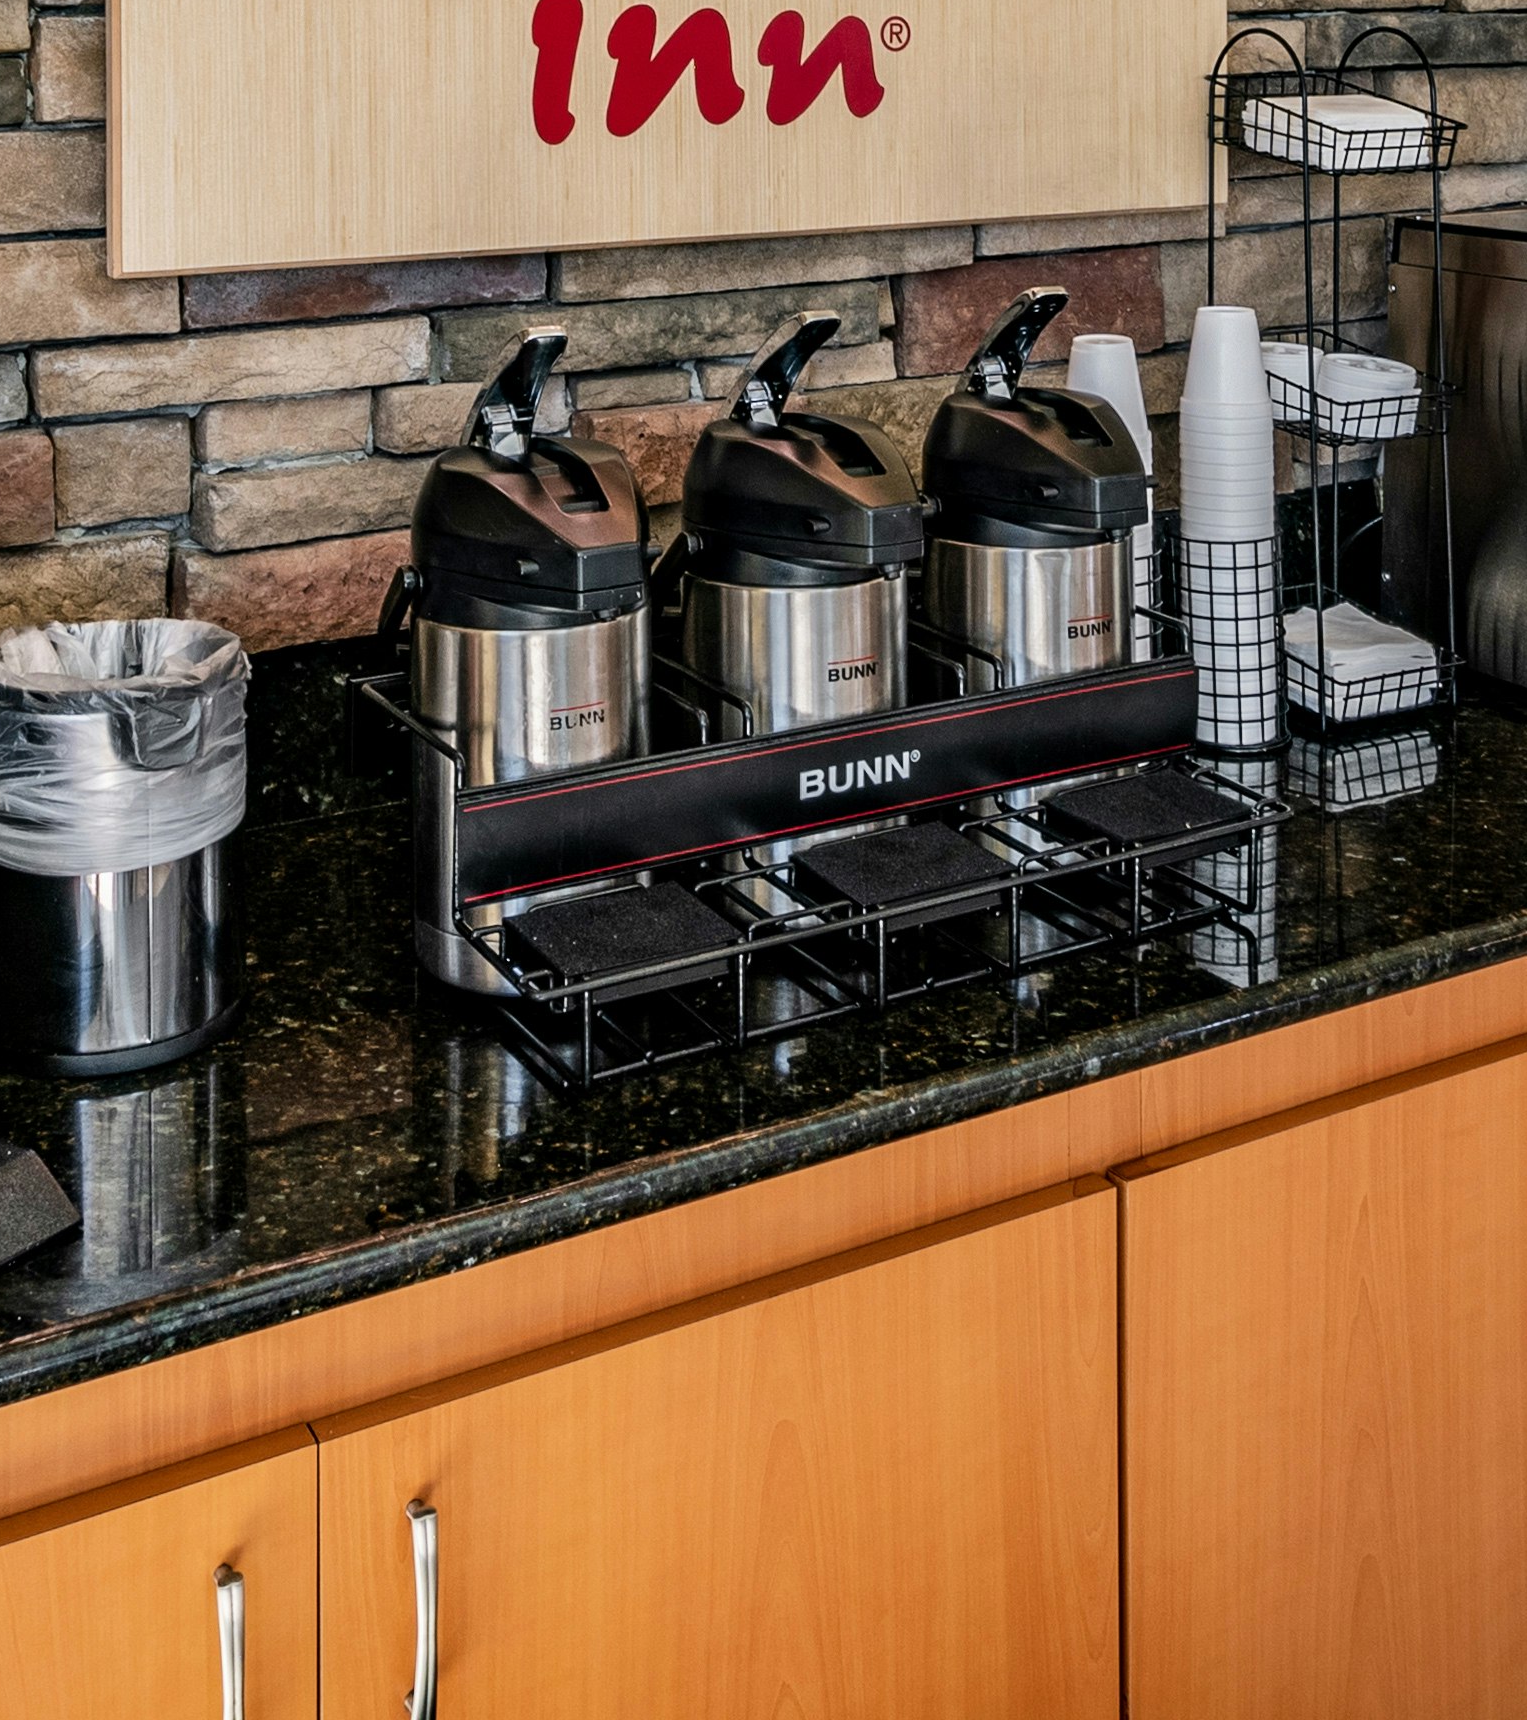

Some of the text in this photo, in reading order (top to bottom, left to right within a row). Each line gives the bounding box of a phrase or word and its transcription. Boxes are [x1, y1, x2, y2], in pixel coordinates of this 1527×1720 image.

[1068, 620, 1111, 640] BUNN
[828, 662, 877, 682] BUNN
[799, 750, 911, 801] BUNN
